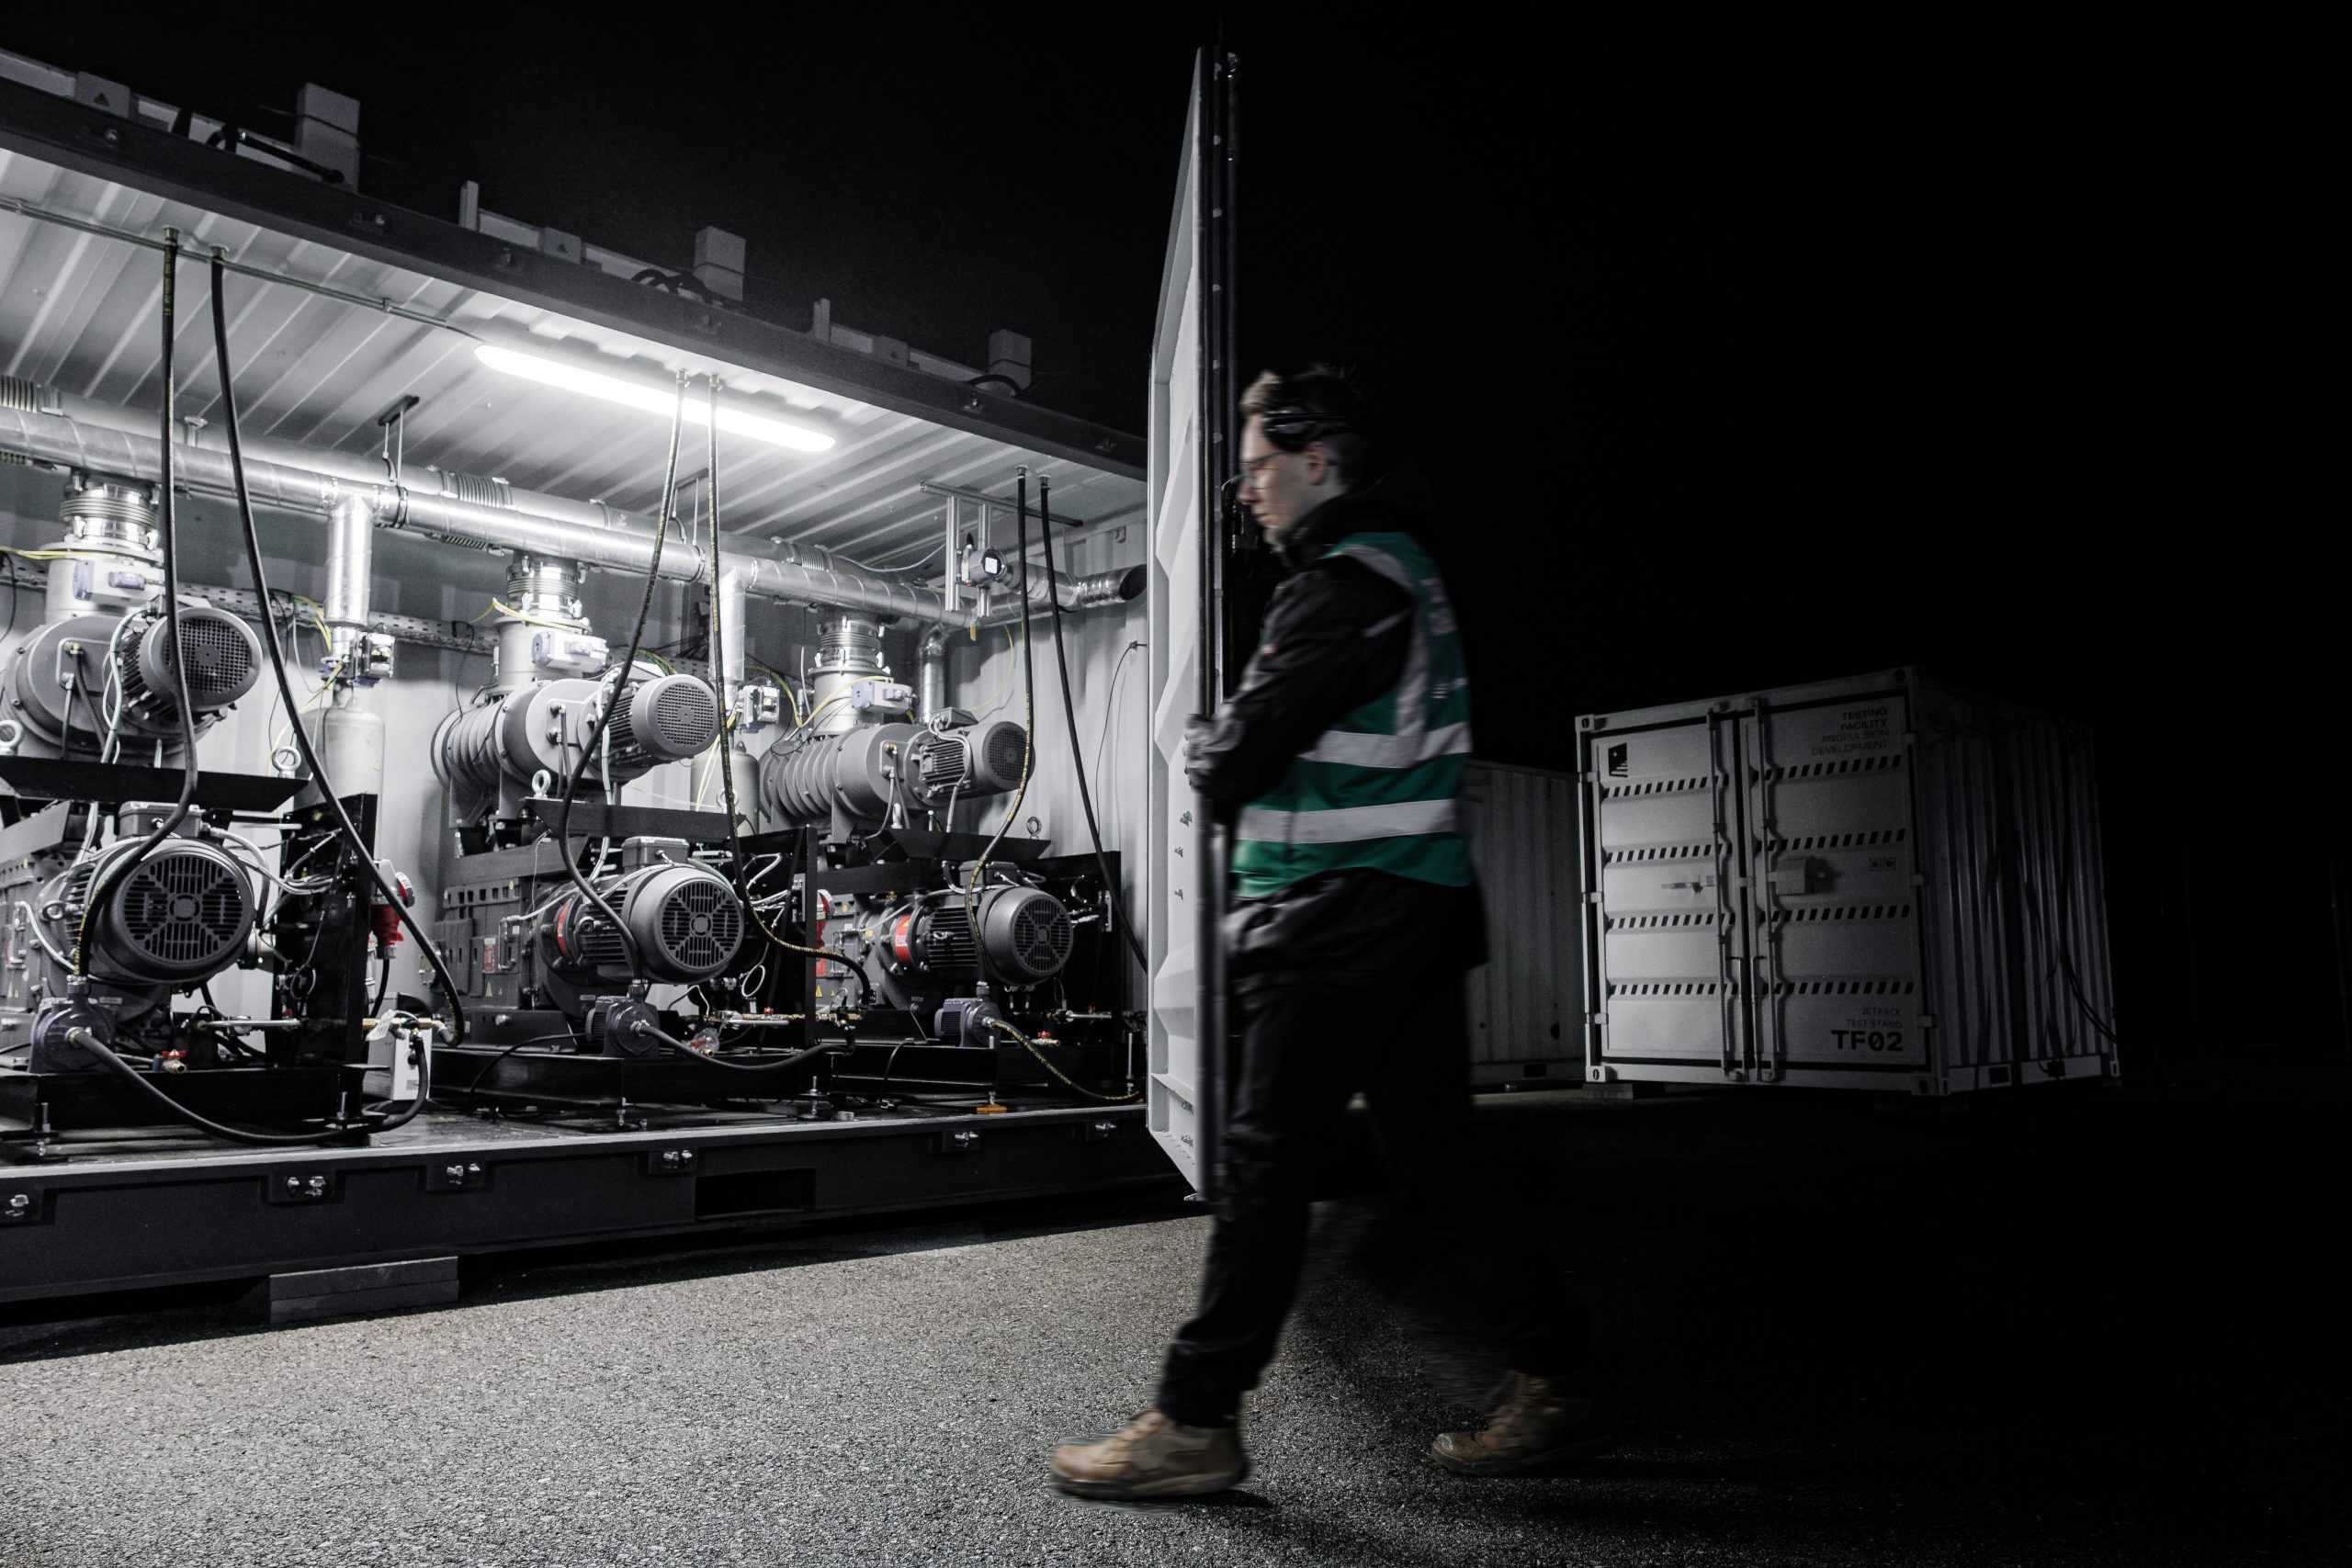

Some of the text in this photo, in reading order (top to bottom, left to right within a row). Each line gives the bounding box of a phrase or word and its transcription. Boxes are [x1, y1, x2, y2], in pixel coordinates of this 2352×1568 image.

[1841, 707, 1887, 720] TESTING
[1840, 718, 1887, 731] FACILITY
[1812, 739, 1889, 756] DEVELOPMENT
[1847, 1019, 1903, 1028] TEST STAND
[1831, 1030, 1903, 1052] TF02
